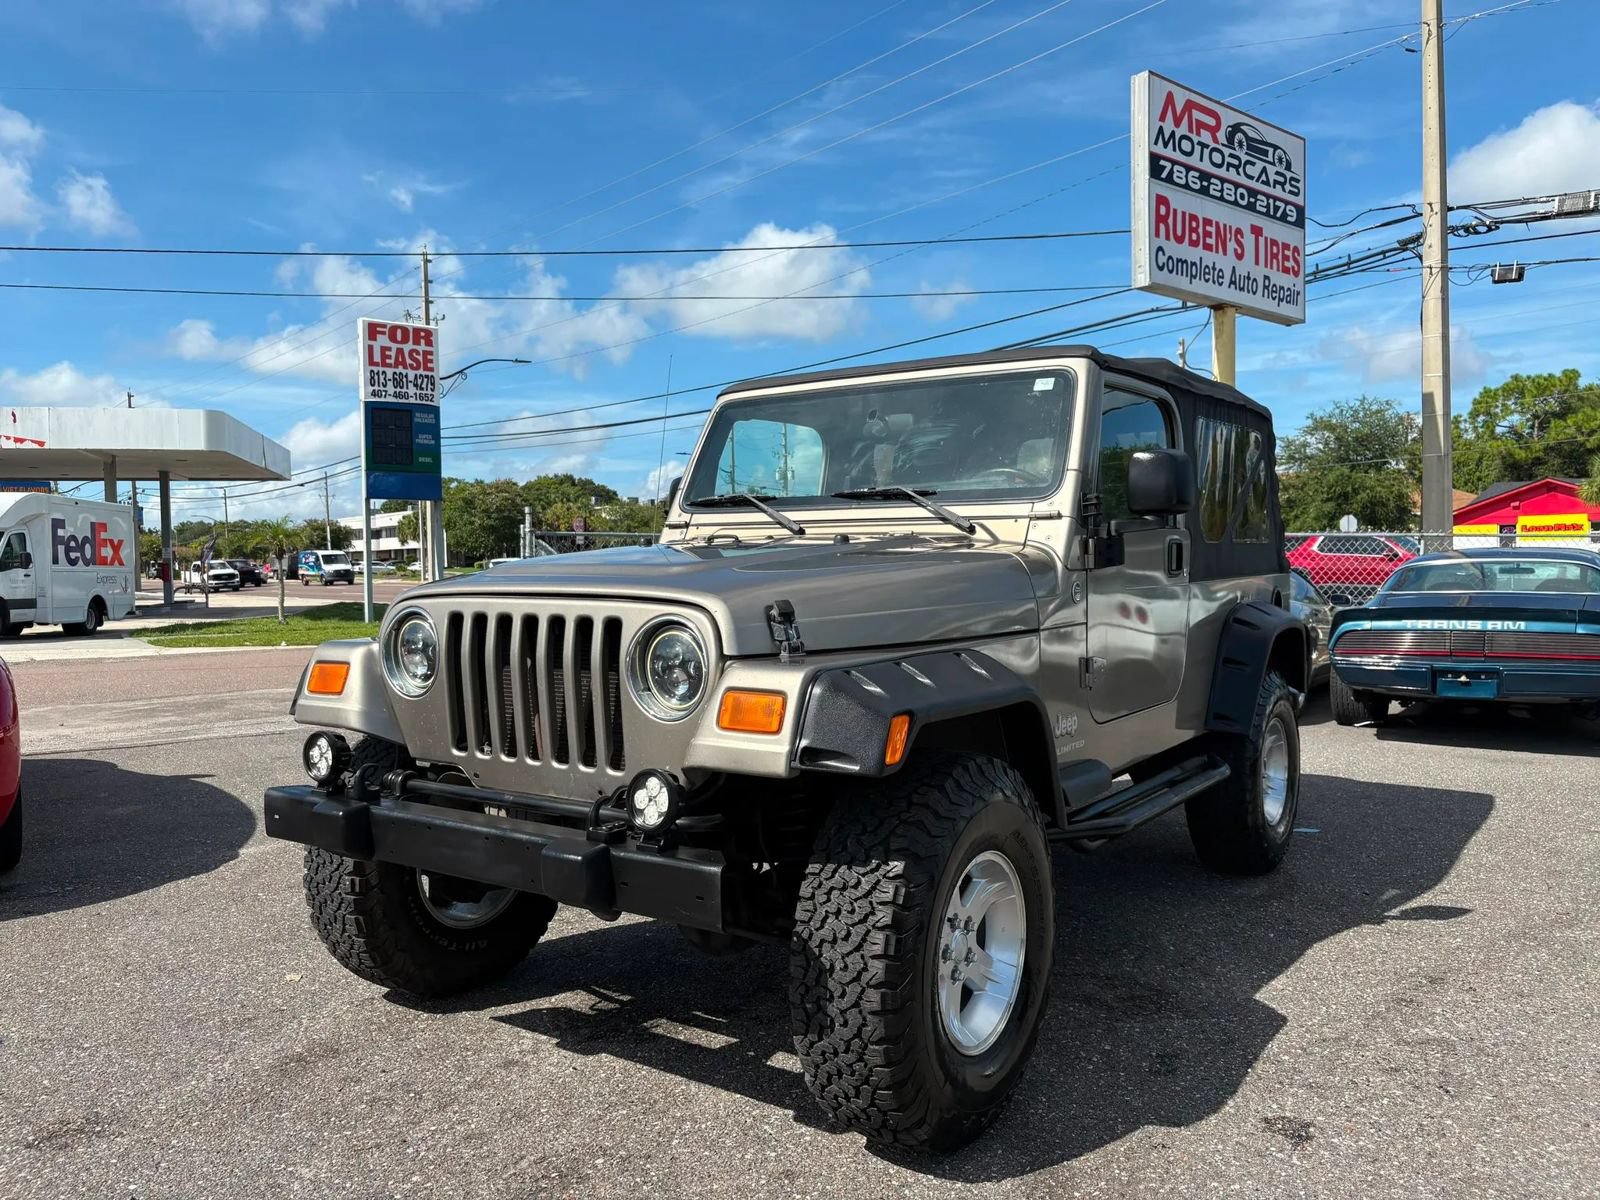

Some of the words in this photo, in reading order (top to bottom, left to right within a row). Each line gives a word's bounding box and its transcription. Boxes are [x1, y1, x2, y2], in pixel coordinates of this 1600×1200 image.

[1158, 90, 1222, 145] MR
[1153, 125, 1301, 197] MOTORCARS
[1159, 160, 1297, 222] 786-280-2179
[1154, 193, 1244, 261] RUBEN'S
[1250, 223, 1300, 279] TIRES
[1155, 246, 1225, 287] Complete
[1228, 265, 1259, 296] Auto
[1262, 275, 1300, 307] Repair
[367, 322, 434, 348] FOR
[367, 344, 435, 372] LEASE
[369, 369, 436, 392] 813-681-4279
[370, 388, 435, 403] 407-460-1652
[51, 518, 125, 568] FedEx
[1402, 619, 1482, 630] TRANS
[1487, 620, 1526, 630] AM
[1054, 713, 1078, 738] Jeep
[1056, 739, 1085, 756] LIMITED
